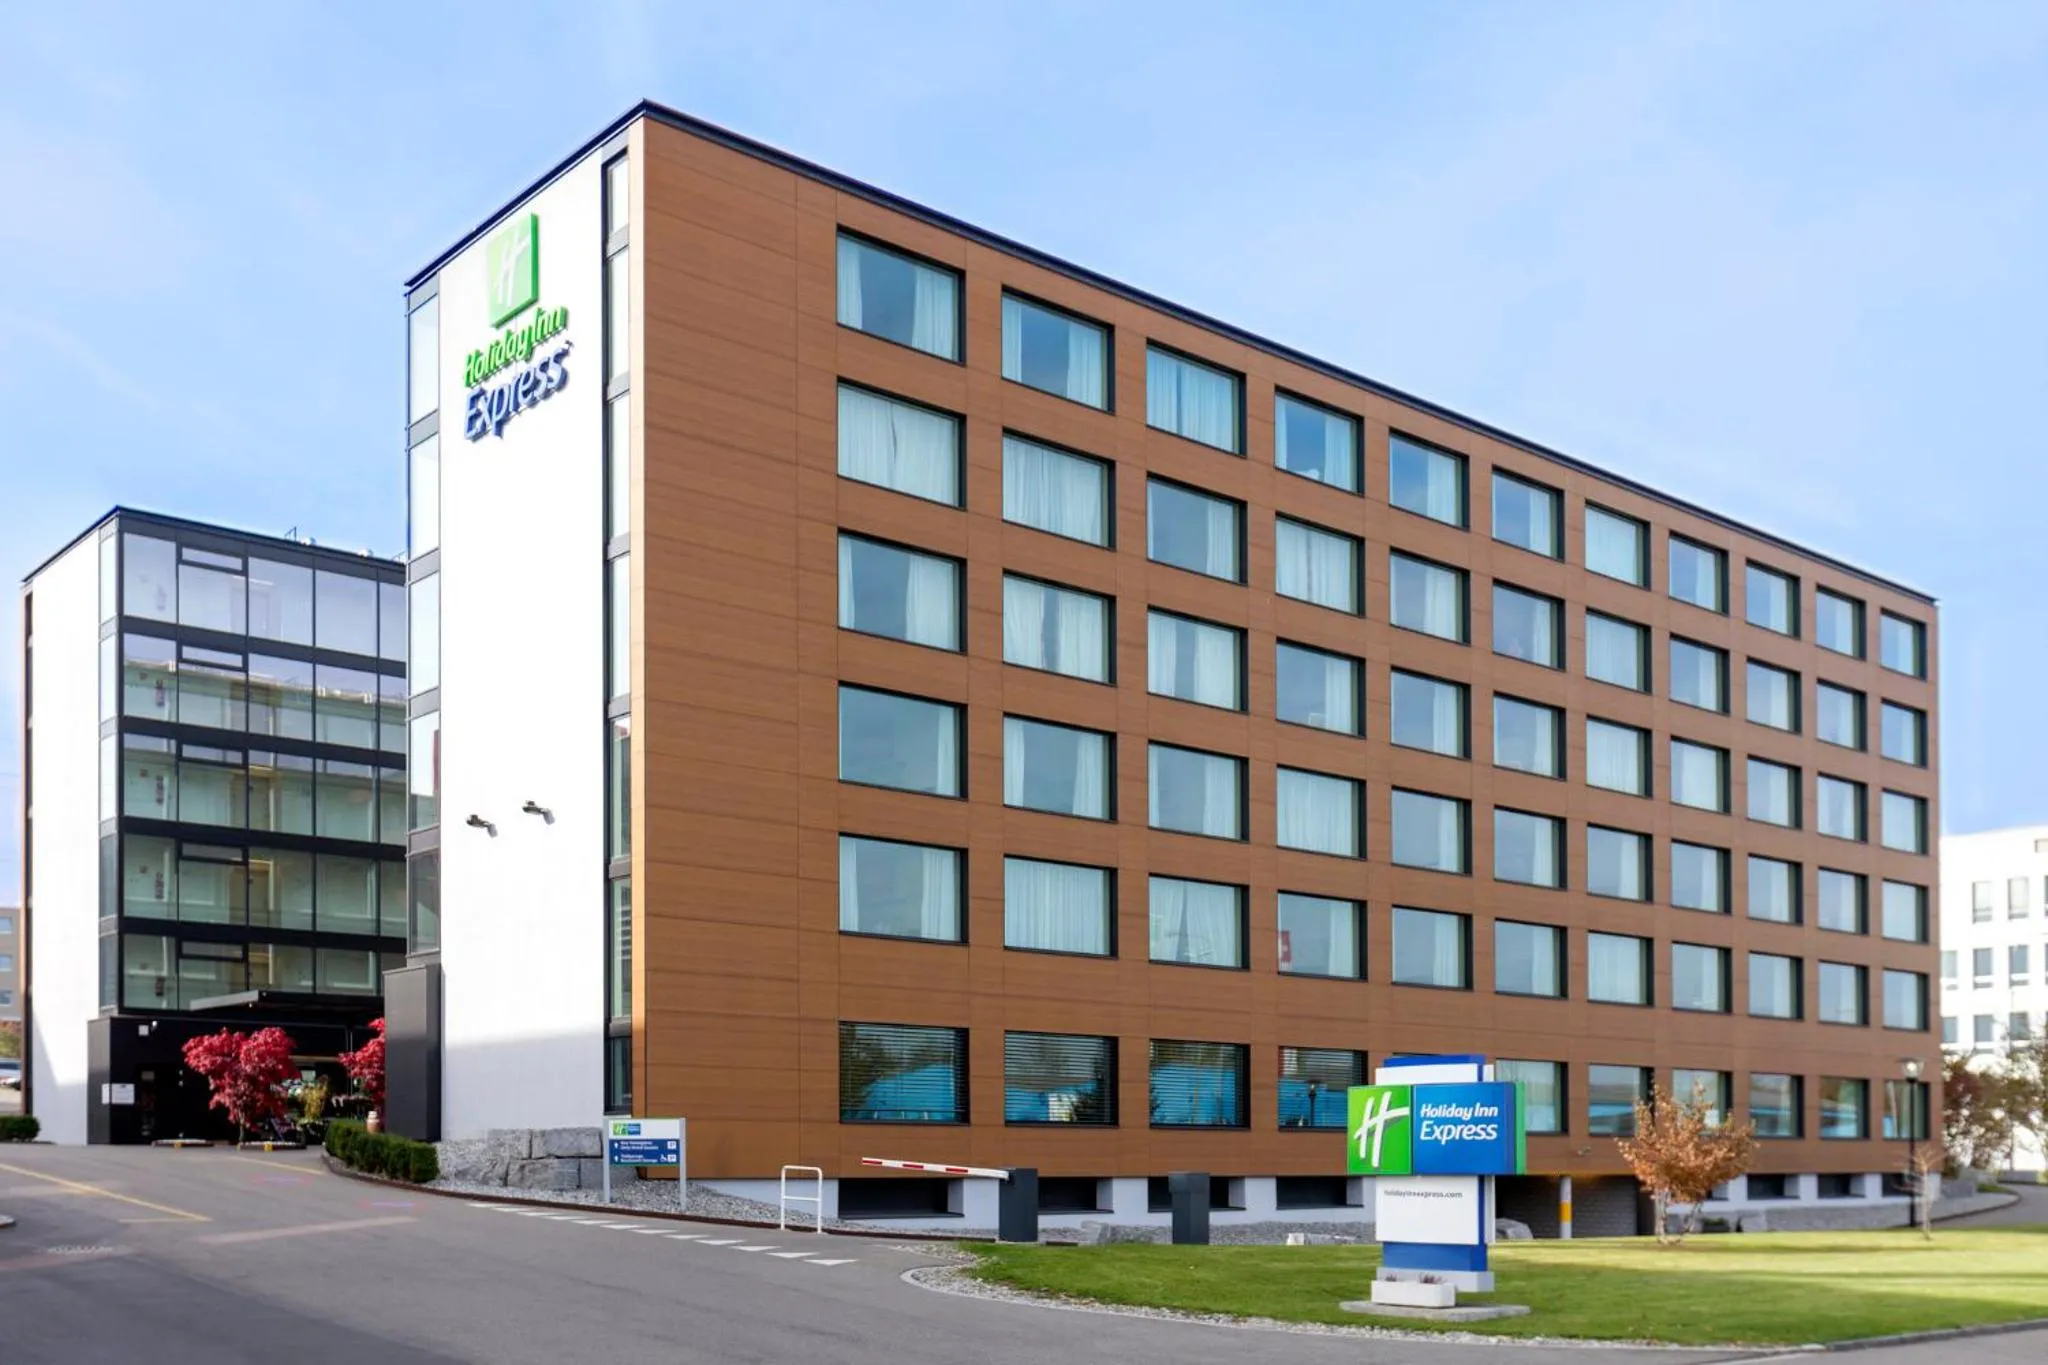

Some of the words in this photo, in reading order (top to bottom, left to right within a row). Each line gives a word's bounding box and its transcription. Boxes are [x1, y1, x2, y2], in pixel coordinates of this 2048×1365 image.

[464, 325, 536, 388] Holiday
[531, 306, 569, 345] Inn
[464, 345, 571, 441] Express
[1420, 1103, 1473, 1121] Holiday
[1475, 1102, 1498, 1117] Inn
[1420, 1120, 1498, 1144] Express
